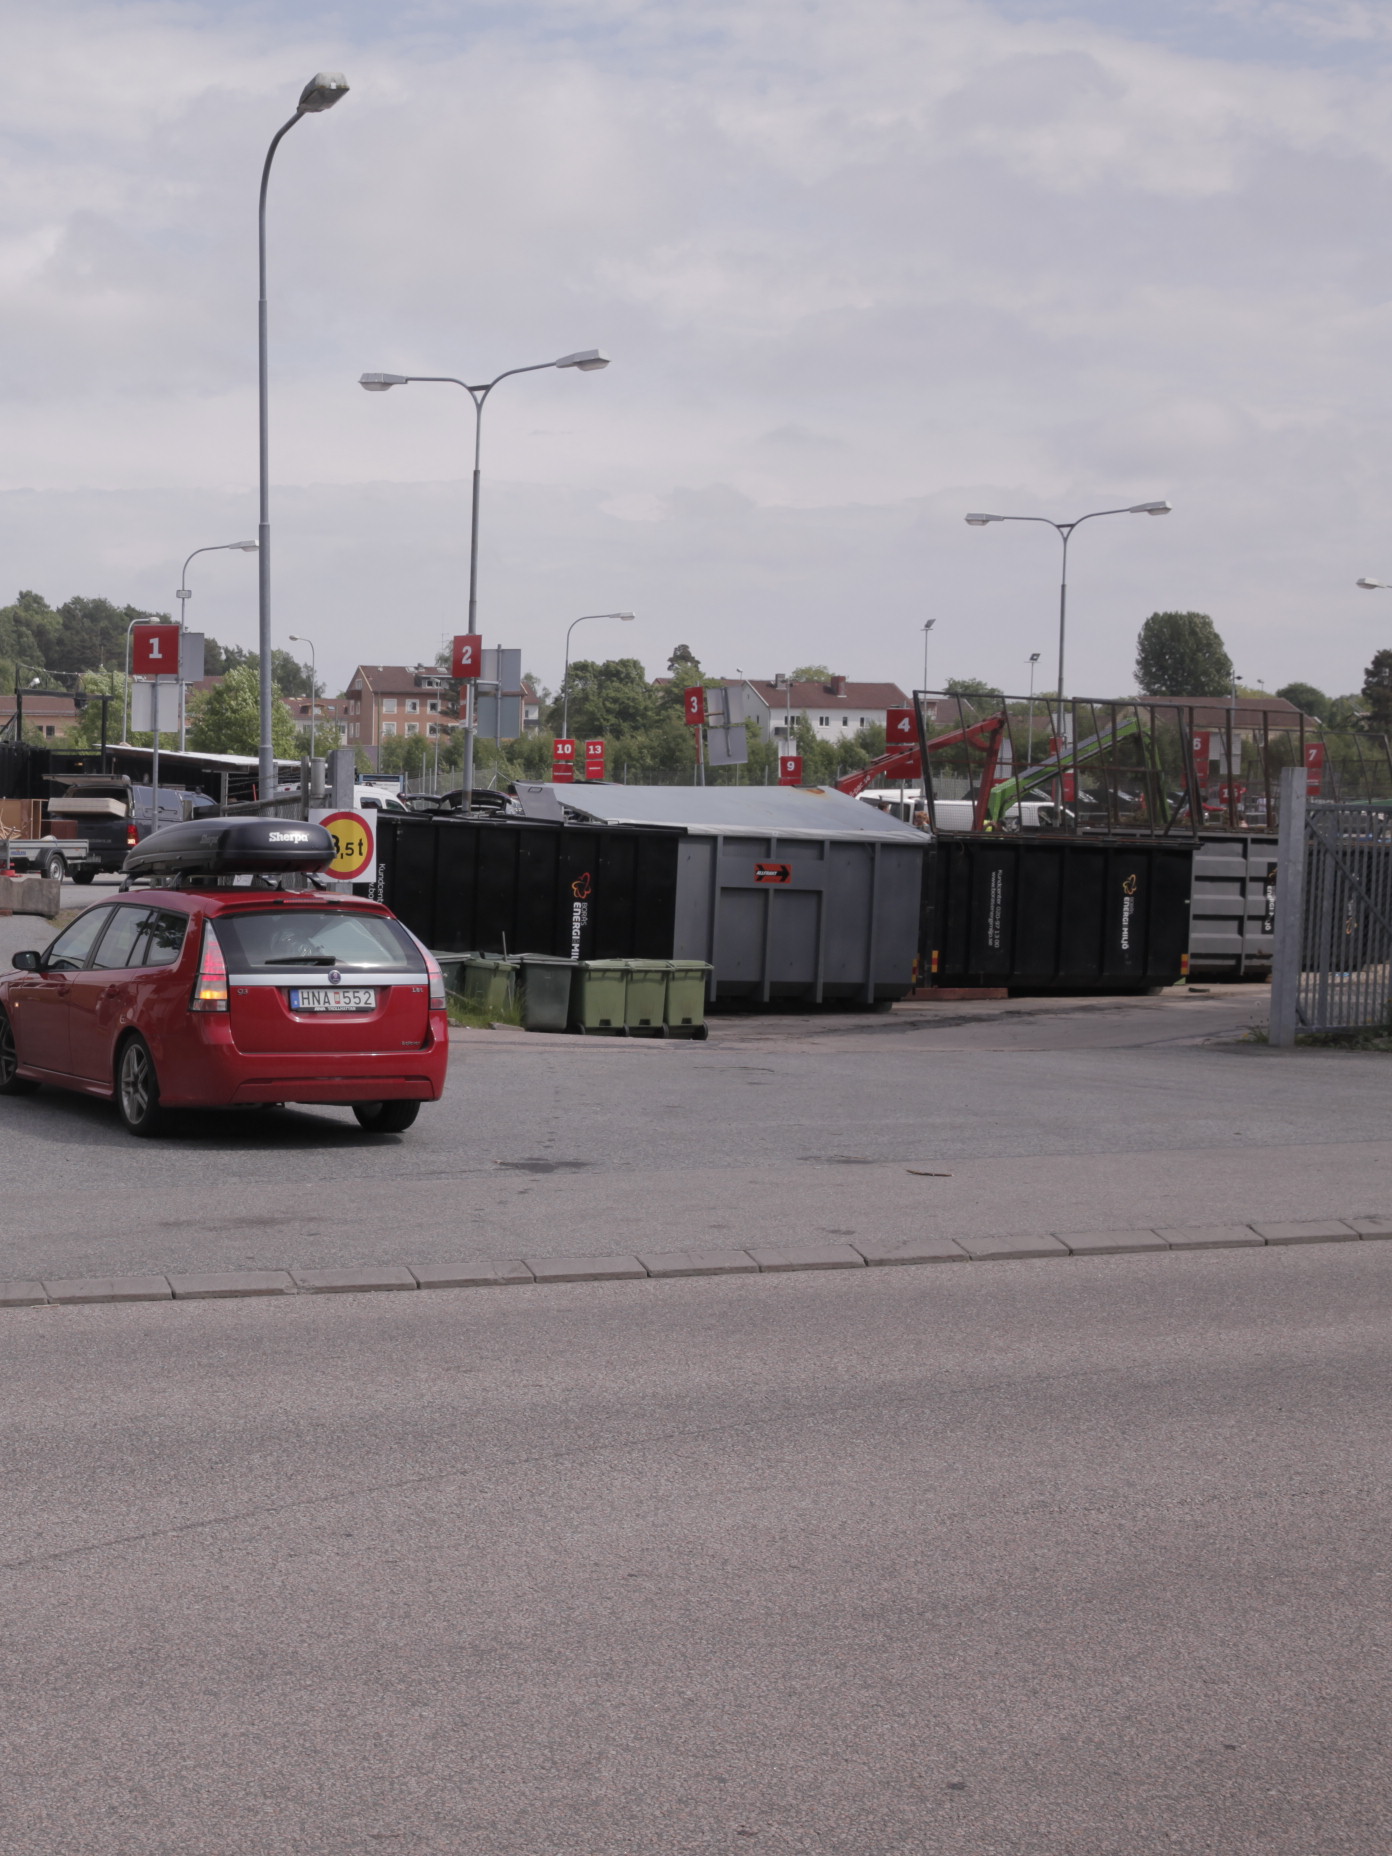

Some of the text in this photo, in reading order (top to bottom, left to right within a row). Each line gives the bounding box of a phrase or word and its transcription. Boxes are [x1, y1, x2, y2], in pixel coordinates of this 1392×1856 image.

[149, 637, 163, 659] 1
[462, 646, 472, 665] 2
[691, 696, 698, 713] 3
[897, 717, 910, 732] 4
[557, 744, 572, 754] 10
[588, 745, 602, 754] 13
[1308, 749, 1317, 761] 7
[787, 761, 795, 771] 9
[269, 832, 309, 844] Sherpa
[358, 838, 363, 856] t
[572, 902, 581, 939] ENERGI
[1121, 927, 1129, 949] MILJÖ
[301, 991, 373, 1006] HNA 552
